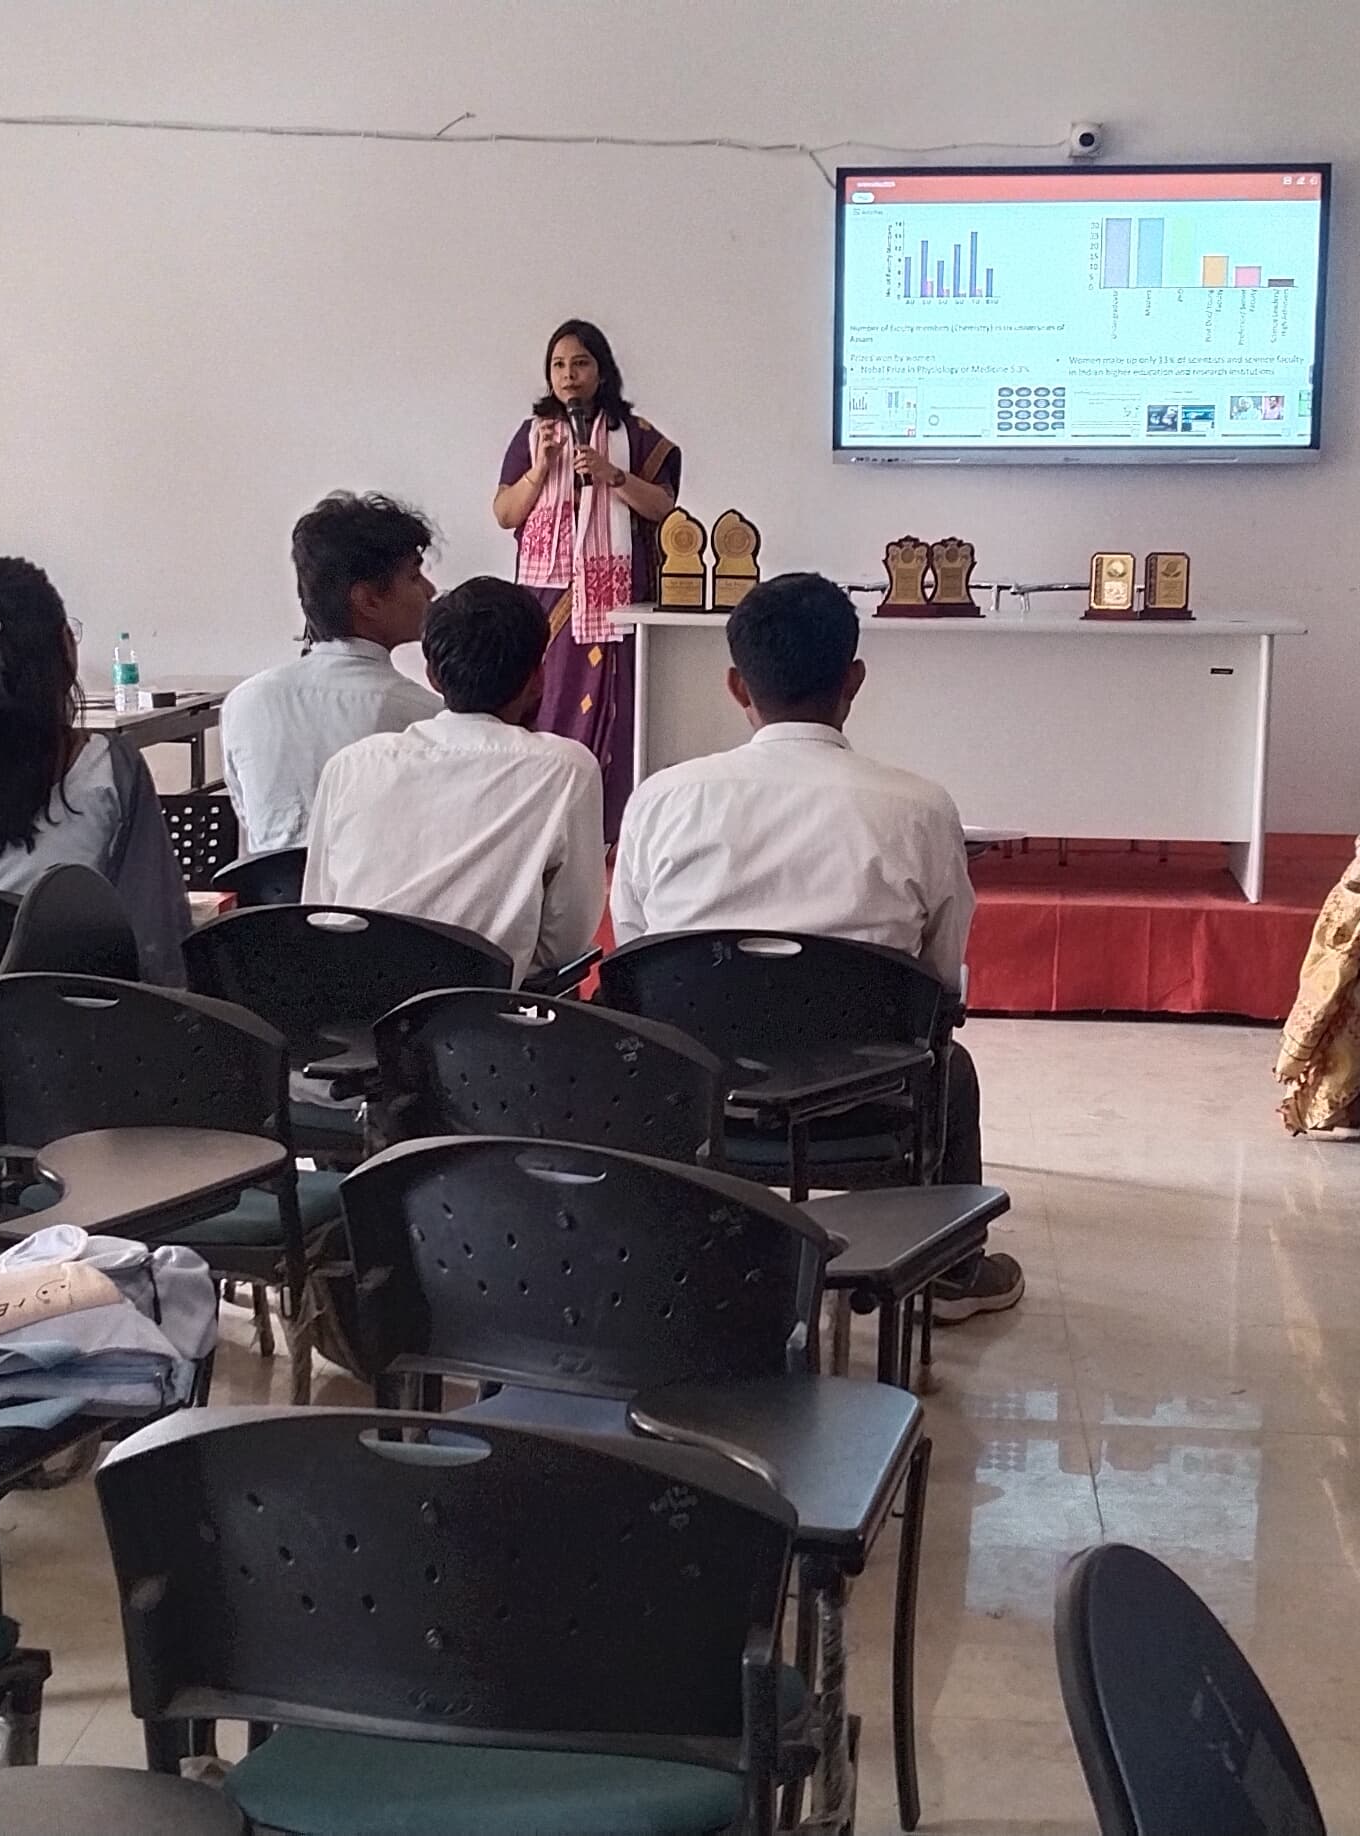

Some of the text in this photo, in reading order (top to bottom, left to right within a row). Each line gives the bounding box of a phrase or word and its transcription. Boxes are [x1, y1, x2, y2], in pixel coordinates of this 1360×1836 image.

[880, 324, 889, 332] of
[850, 353, 873, 362] Prizes
[894, 353, 904, 364] by
[1069, 356, 1100, 364] Women
[1102, 356, 1124, 364] make
[1138, 356, 1157, 366] only
[1188, 356, 1225, 364] scientists
[1227, 356, 1242, 364] and
[1244, 356, 1274, 364] science
[1276, 355, 1304, 366] faculty
[917, 366, 959, 376] Physiology
[971, 365, 1009, 374] Medicine
[1078, 368, 1103, 376] Indian
[1105, 368, 1132, 378] higher
[1133, 368, 1173, 376] education
[1175, 368, 1191, 376] and
[1192, 368, 1227, 376] research
[1229, 367, 1275, 376] institutions
